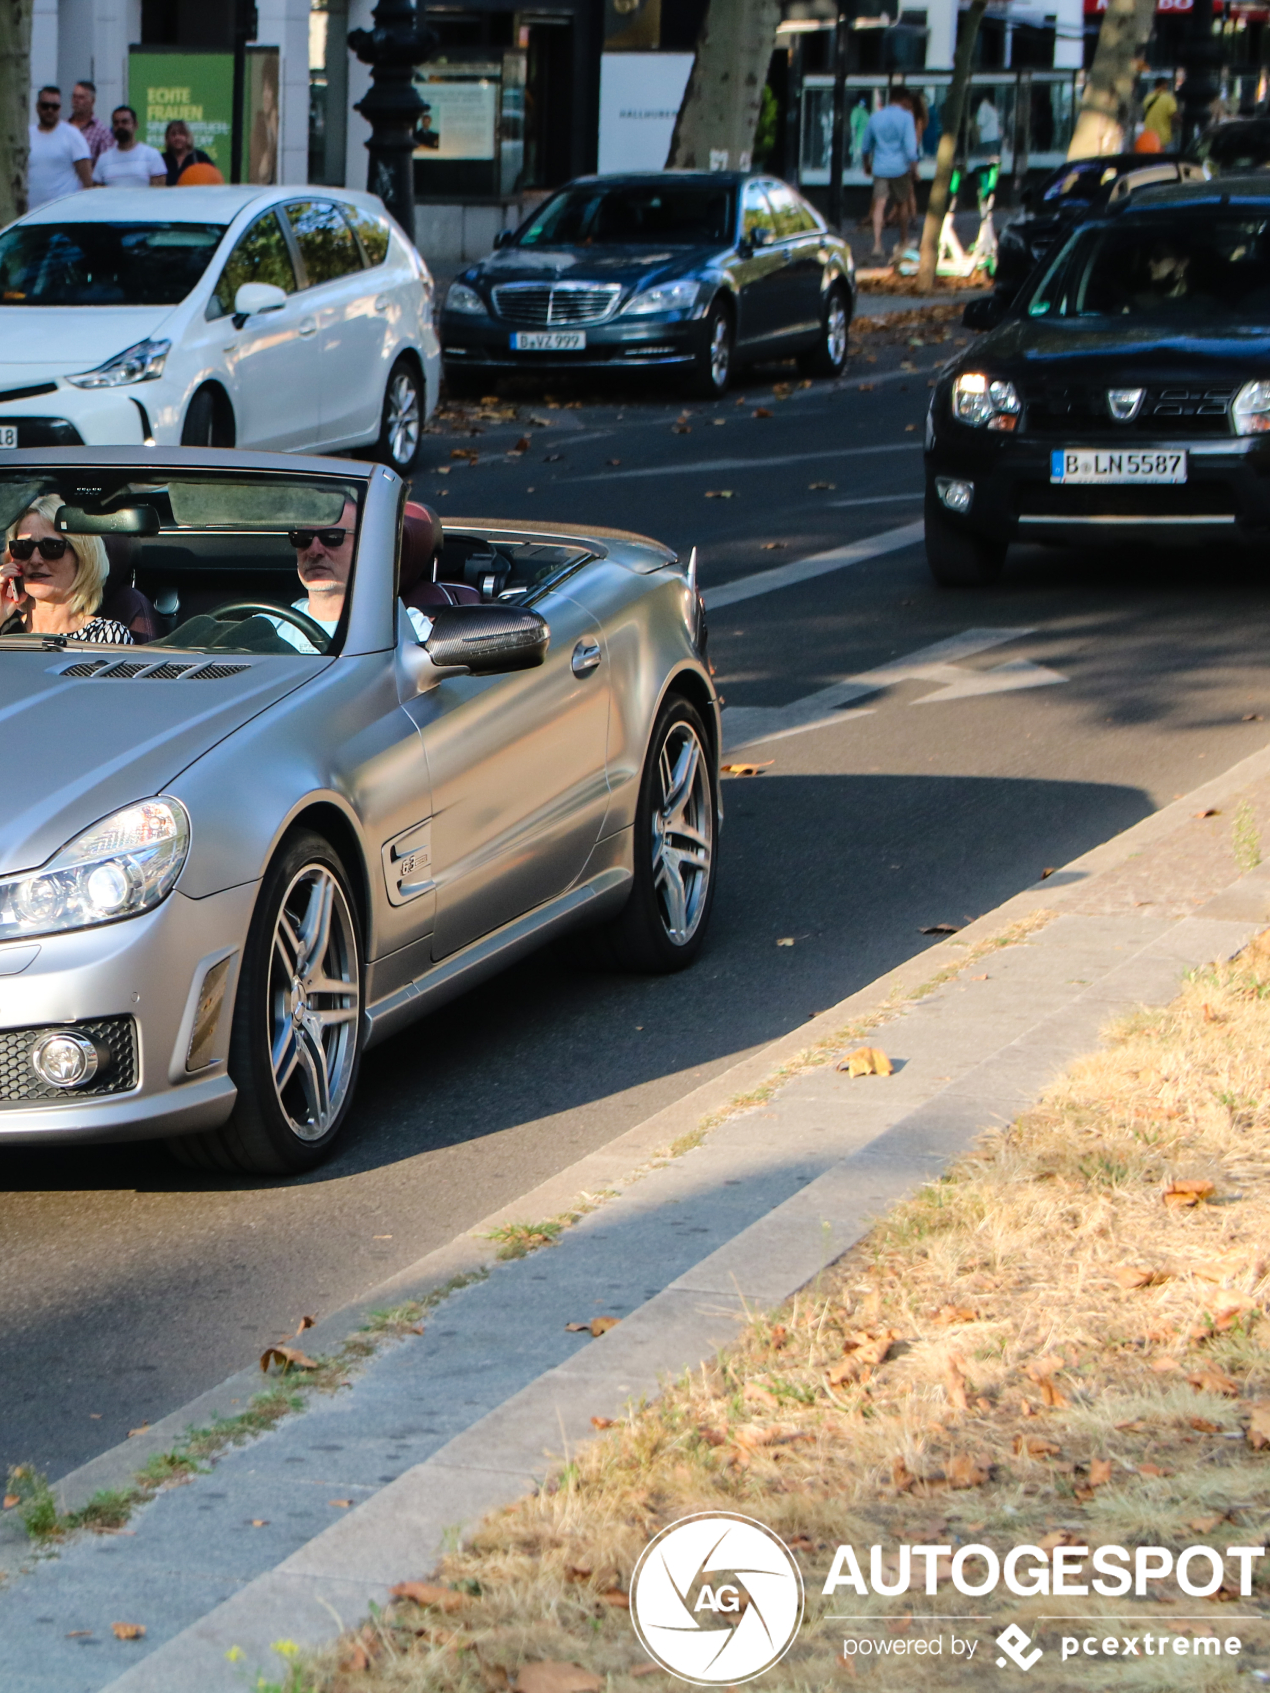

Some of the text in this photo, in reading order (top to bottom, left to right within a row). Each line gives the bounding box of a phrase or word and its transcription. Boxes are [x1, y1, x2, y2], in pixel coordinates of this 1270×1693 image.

[147, 87, 191, 103] ECHTE
[147, 104, 203, 121] FRAUEN
[554, 335, 579, 348] 999
[1066, 455, 1182, 475] B LN 5587
